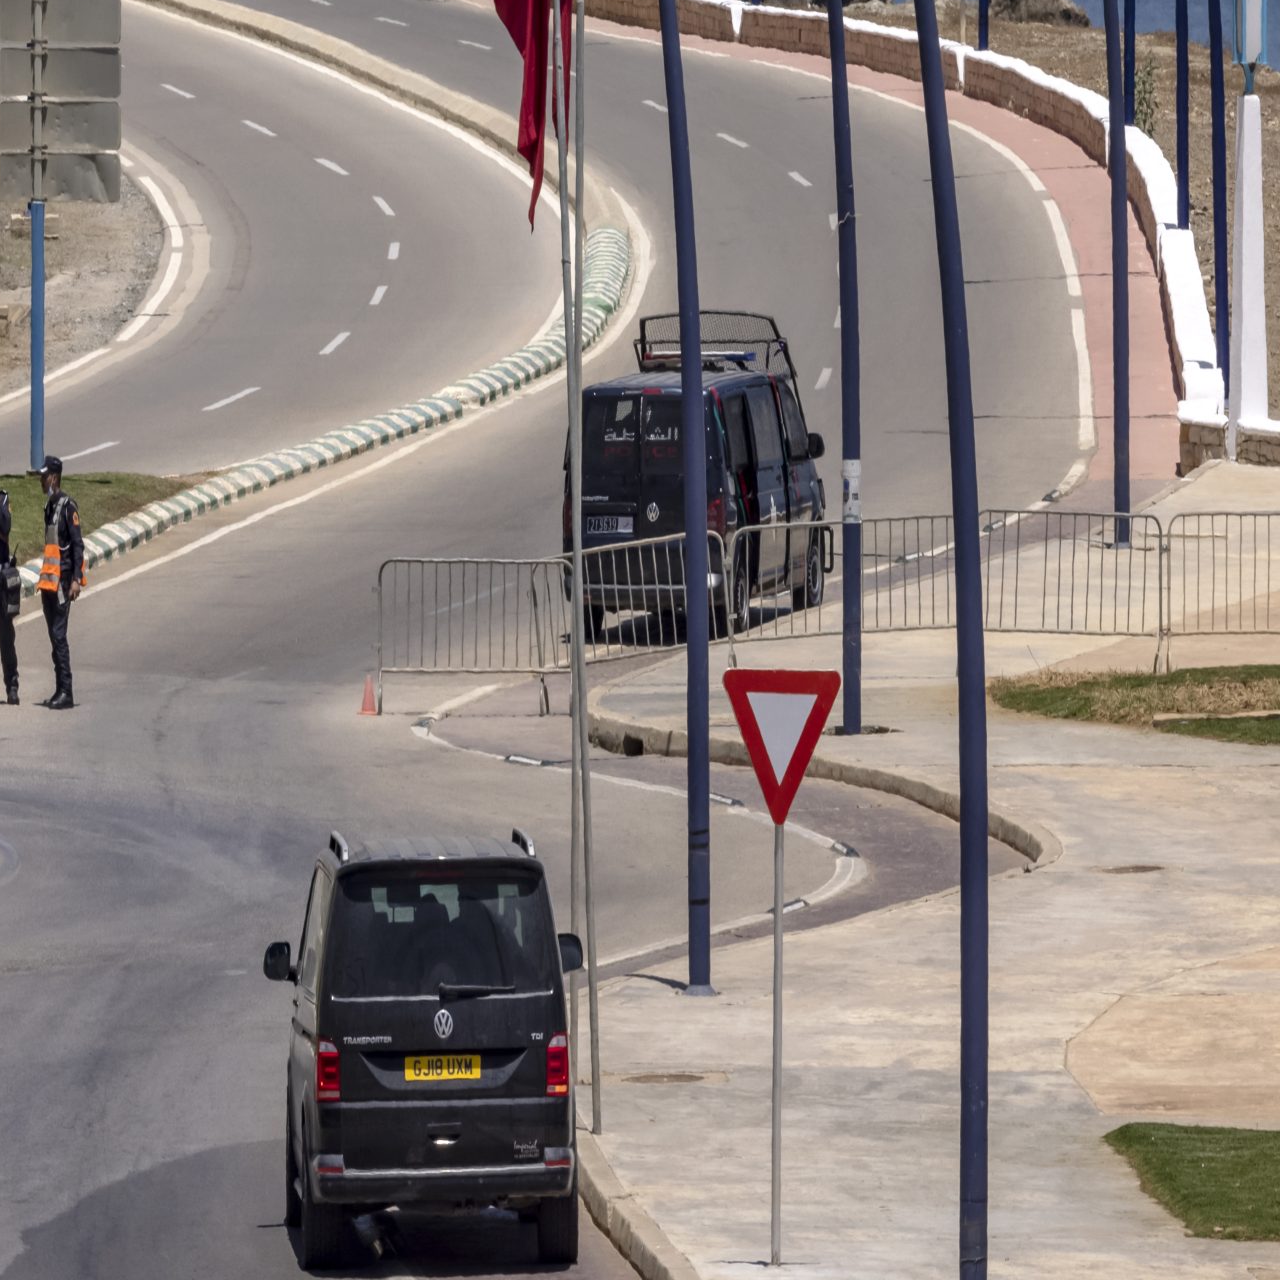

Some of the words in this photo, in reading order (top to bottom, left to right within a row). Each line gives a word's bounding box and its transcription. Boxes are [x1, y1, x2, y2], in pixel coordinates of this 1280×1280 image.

[343, 1035, 393, 1045] TRANSPORTER
[531, 1032, 544, 1041] TDI
[413, 1057, 443, 1077] GJ18
[447, 1057, 473, 1076] UXM
